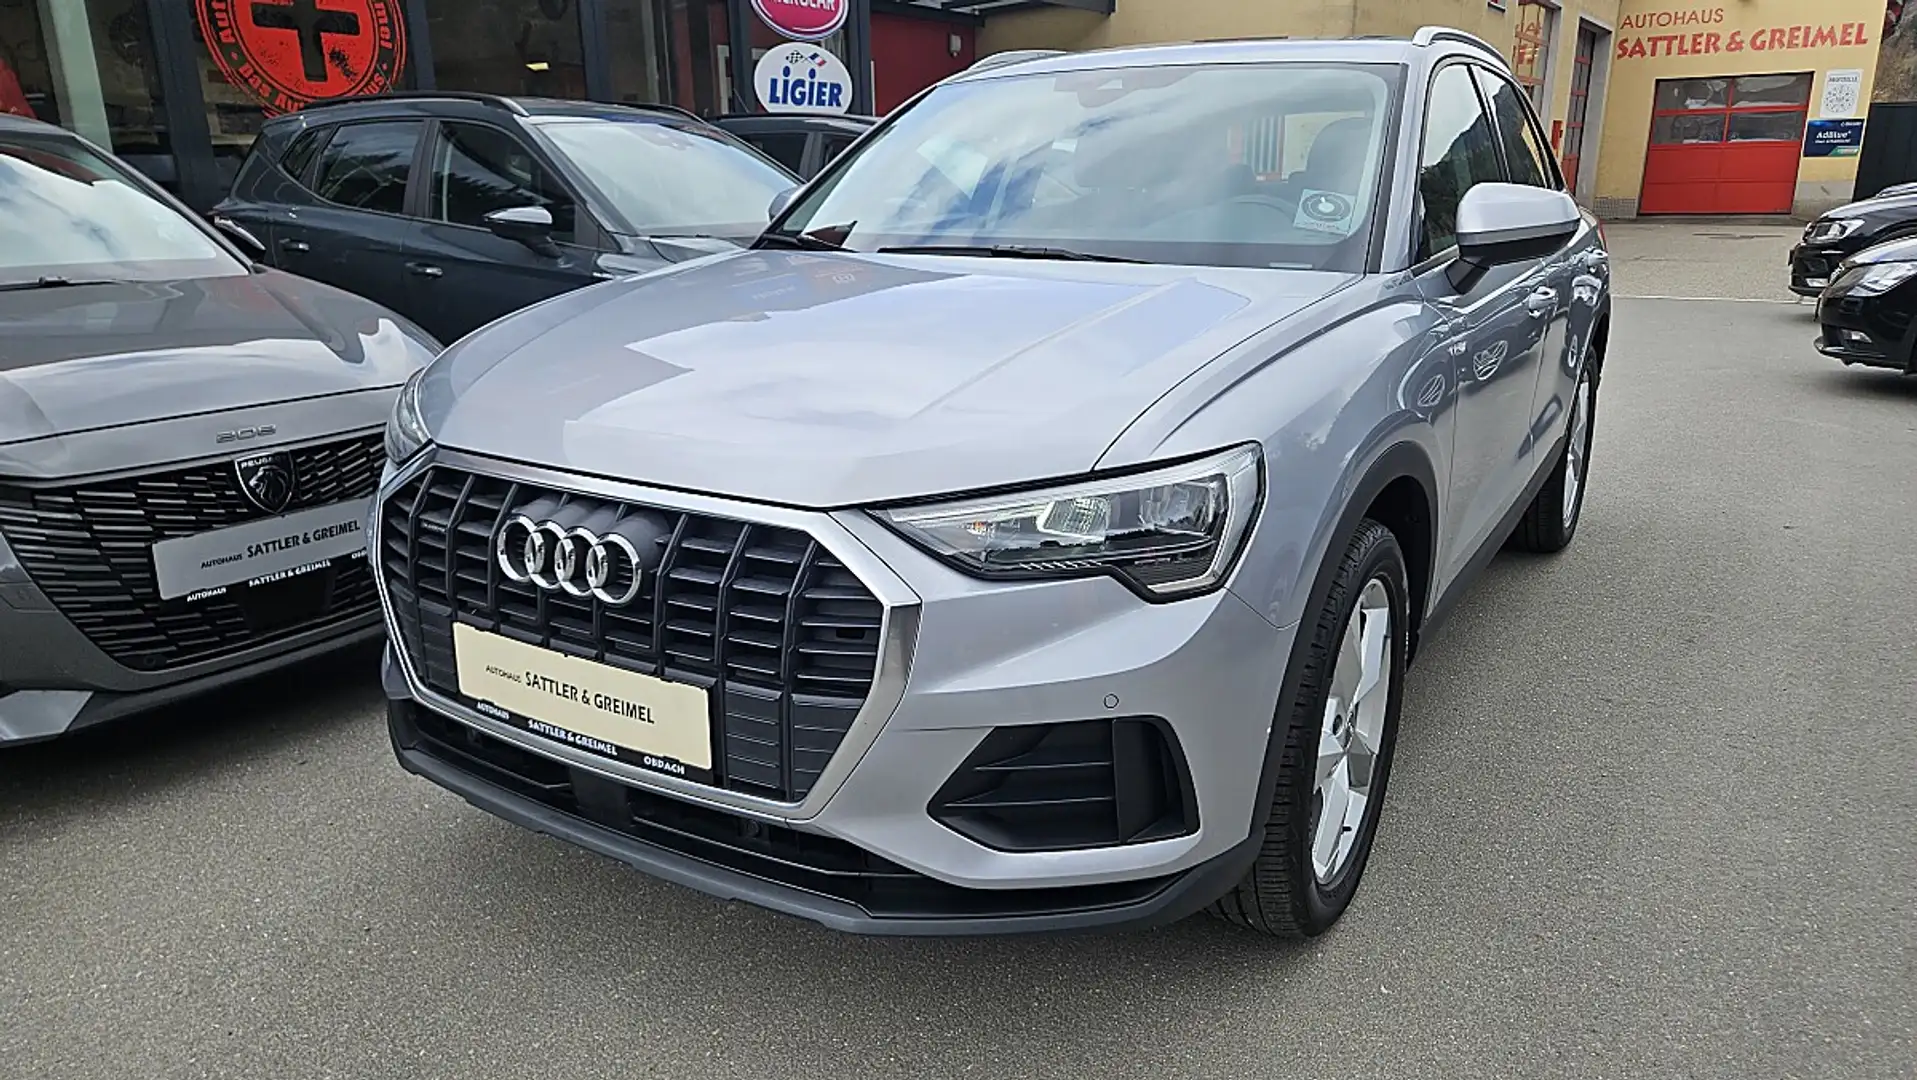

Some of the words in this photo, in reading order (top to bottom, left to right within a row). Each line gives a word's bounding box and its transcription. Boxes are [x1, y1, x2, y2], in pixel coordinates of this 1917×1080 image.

[1619, 8, 1724, 30] AUTOHAUS
[1616, 32, 1722, 60] SATTLER
[1725, 30, 1744, 52] &
[1748, 22, 1869, 51] GREIMEL
[768, 66, 843, 107] LIGIER
[201, 553, 243, 569] AUTOHAUS
[246, 534, 300, 558] SATTLER
[302, 532, 311, 544] &
[312, 520, 361, 542] GREIMEL
[187, 587, 227, 602] AUTOHAUS
[248, 570, 286, 587] SATTLER
[287, 569, 294, 578] &
[295, 559, 332, 576] GREIMEL
[485, 664, 522, 684] AUTOHAUS
[525, 671, 578, 702] SATTLER
[581, 689, 591, 705] &
[594, 693, 655, 724] GREIMEL
[477, 702, 510, 720] AUTOHAUS
[528, 719, 567, 740] SATTLER
[567, 731, 575, 742] &
[575, 734, 618, 755] GREIMEL
[643, 755, 686, 775] OBDACH
